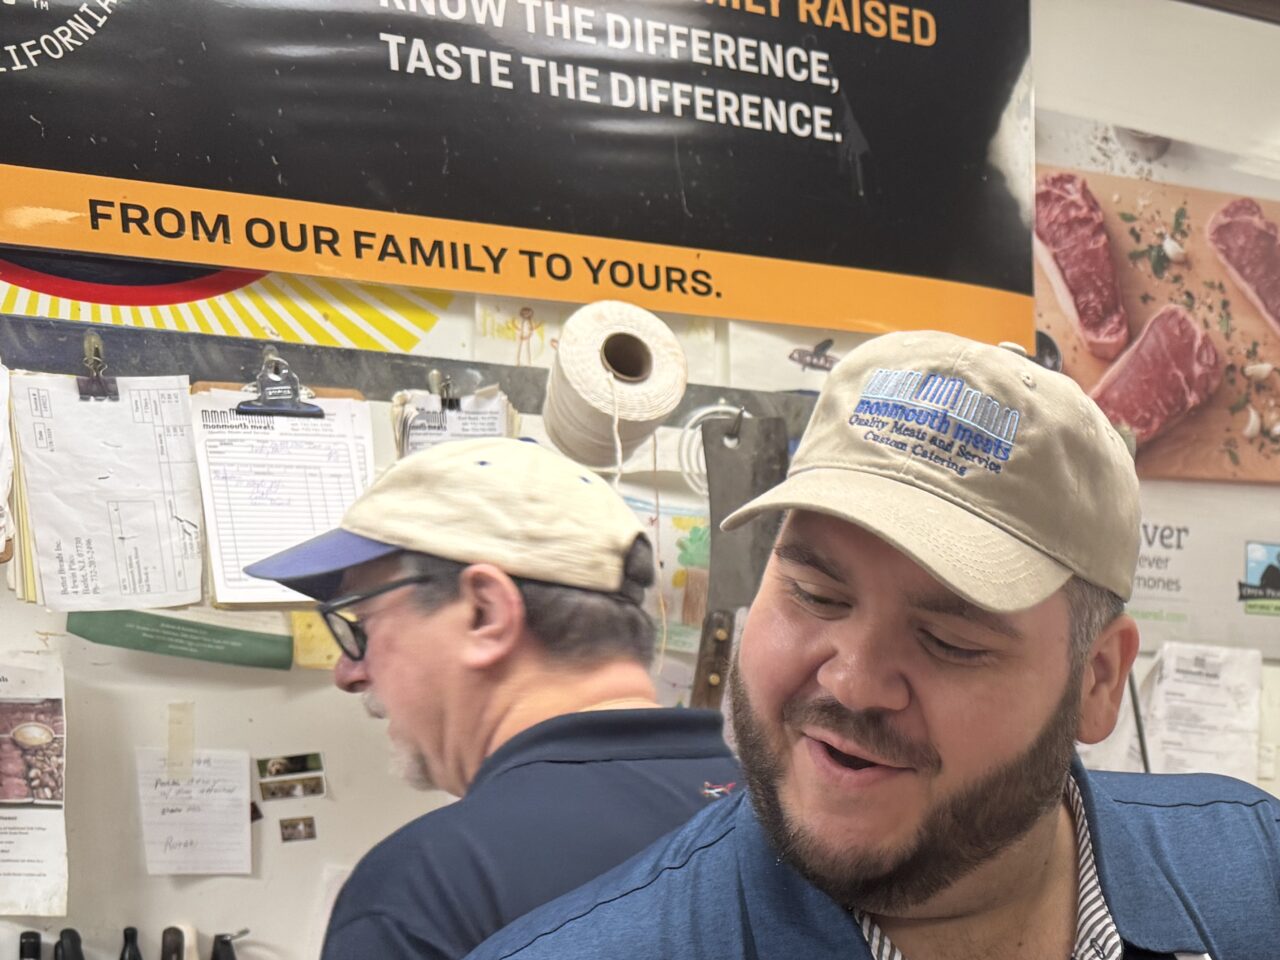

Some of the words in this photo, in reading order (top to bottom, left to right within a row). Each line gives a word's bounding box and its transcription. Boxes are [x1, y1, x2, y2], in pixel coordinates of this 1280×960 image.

[517, 0, 596, 44] THE
[606, 12, 839, 94] DIFFERENCE,
[798, 0, 937, 47] RAISED
[379, 33, 513, 90] TASTE
[521, 56, 601, 104] THE
[609, 72, 842, 143] DIFFERENCE.
[88, 199, 232, 245] FROM
[244, 217, 341, 257] OUR
[353, 230, 509, 275] FAMILY
[518, 249, 573, 281] TO
[582, 256, 722, 299] YOURS.
[848, 414, 888, 430] Quality
[889, 420, 928, 442] Meats
[929, 435, 955, 454] and
[956, 444, 1002, 474] Service
[863, 430, 908, 452] Custom
[911, 444, 968, 477] Catering
[952, 423, 1012, 462] meats
[1142, 523, 1189, 550] ver
